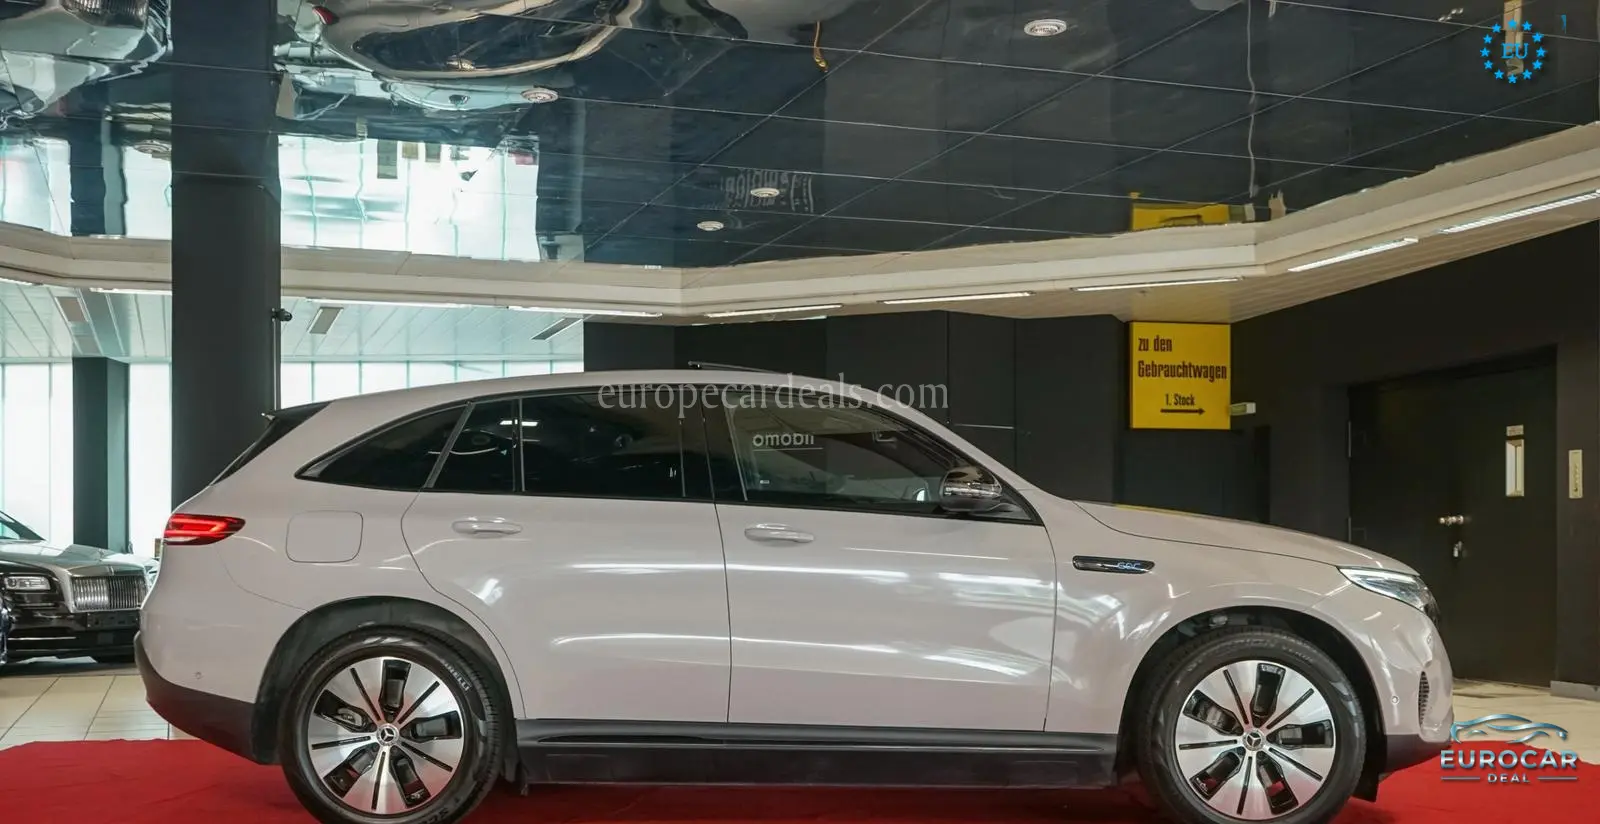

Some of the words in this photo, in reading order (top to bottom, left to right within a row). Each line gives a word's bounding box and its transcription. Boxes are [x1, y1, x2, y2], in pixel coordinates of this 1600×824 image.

[1138, 337, 1149, 352] zu
[1153, 335, 1173, 352] den
[1137, 360, 1227, 383] Gebrauchtwagen
[1173, 393, 1195, 406] Stock
